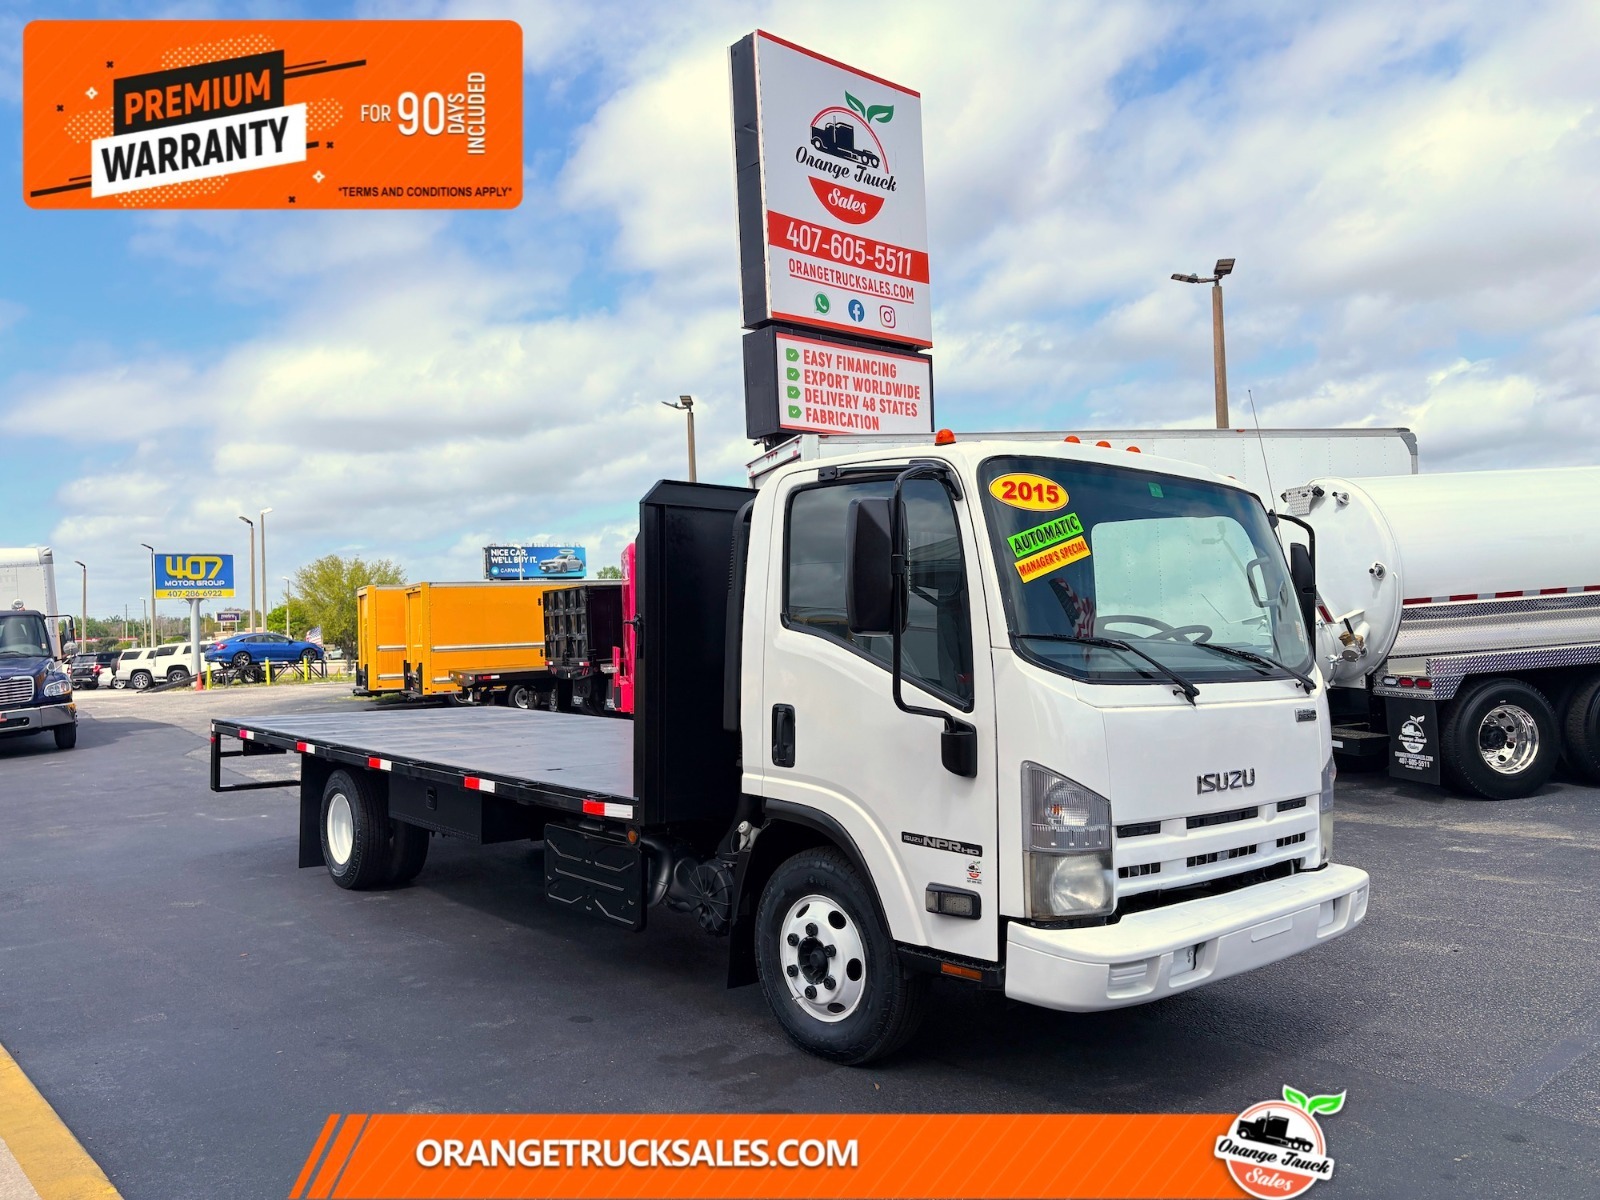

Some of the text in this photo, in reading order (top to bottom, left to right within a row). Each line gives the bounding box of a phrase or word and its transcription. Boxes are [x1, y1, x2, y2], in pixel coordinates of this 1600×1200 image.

[795, 146, 897, 191] Orange Truck
[828, 188, 867, 215] Sales
[786, 221, 912, 276] 407-605-5511
[788, 258, 914, 300] ORANGETRUCKSALES.COM
[804, 349, 897, 378] EASY FINANCING
[804, 369, 920, 400] EXPORT WORLDWIDE
[804, 388, 918, 417] DELIVERY 48 STATES
[806, 407, 879, 430] FABRICATION
[1002, 481, 1059, 504] 2015
[1015, 515, 1079, 553] AUTOMATIC
[166, 556, 223, 580] 407
[491, 556, 513, 564] WE'LL
[1019, 540, 1087, 576] MANAGER'S SPECIAL
[1196, 768, 1255, 795] ISUZU
[904, 834, 923, 843] ISUZU
